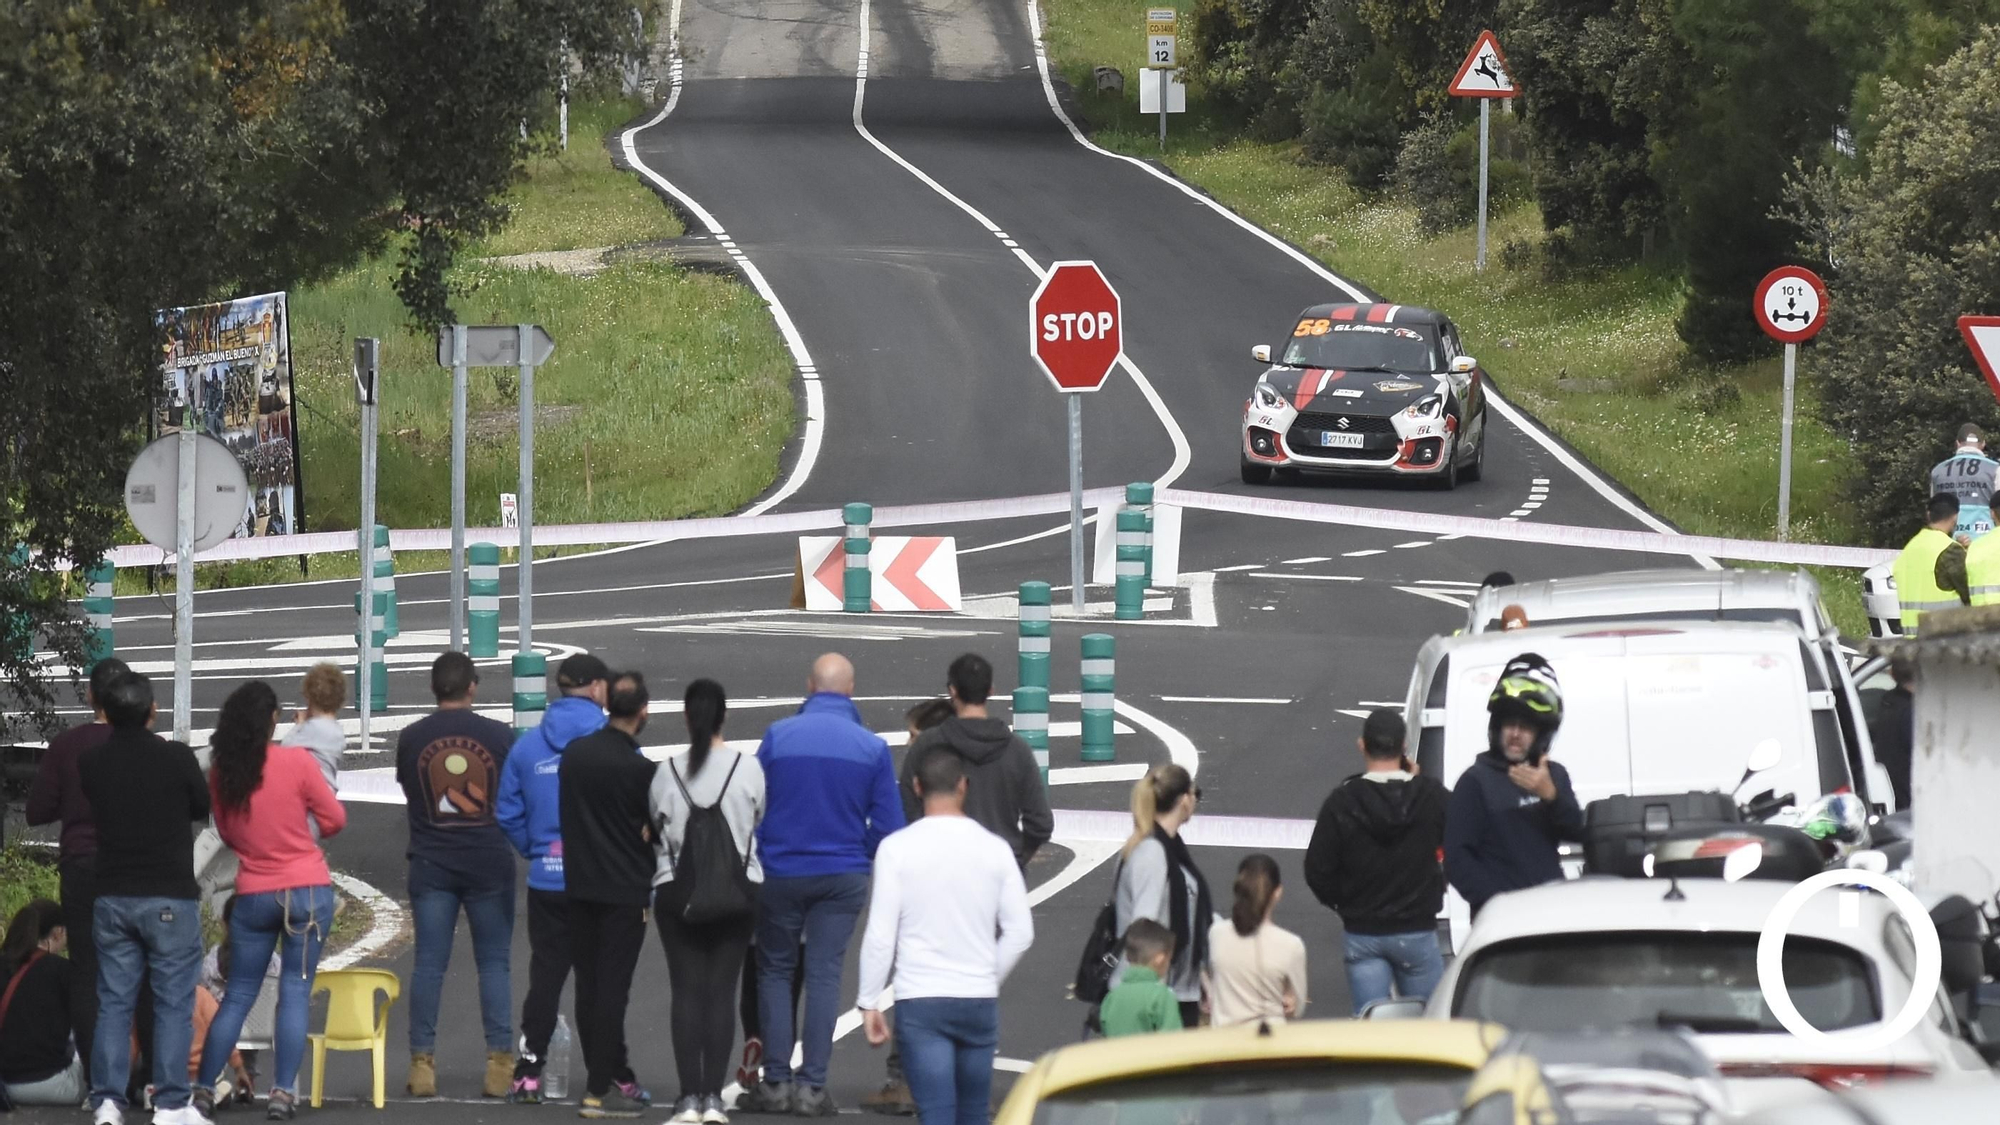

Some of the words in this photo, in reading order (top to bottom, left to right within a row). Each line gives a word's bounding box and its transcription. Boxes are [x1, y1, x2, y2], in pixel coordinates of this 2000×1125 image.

[1155, 51, 1169, 61] 12
[1782, 286, 1795, 296] 10
[1797, 286, 1803, 296] t
[1043, 311, 1114, 341] STOP
[1294, 319, 1330, 337] 58
[178, 357, 199, 368] BRIGADA
[225, 350, 233, 360] EL
[254, 346, 260, 356] X
[1328, 435, 1347, 444] 2717
[1348, 436, 1362, 445] KVJ
[1944, 457, 1981, 477] 118
